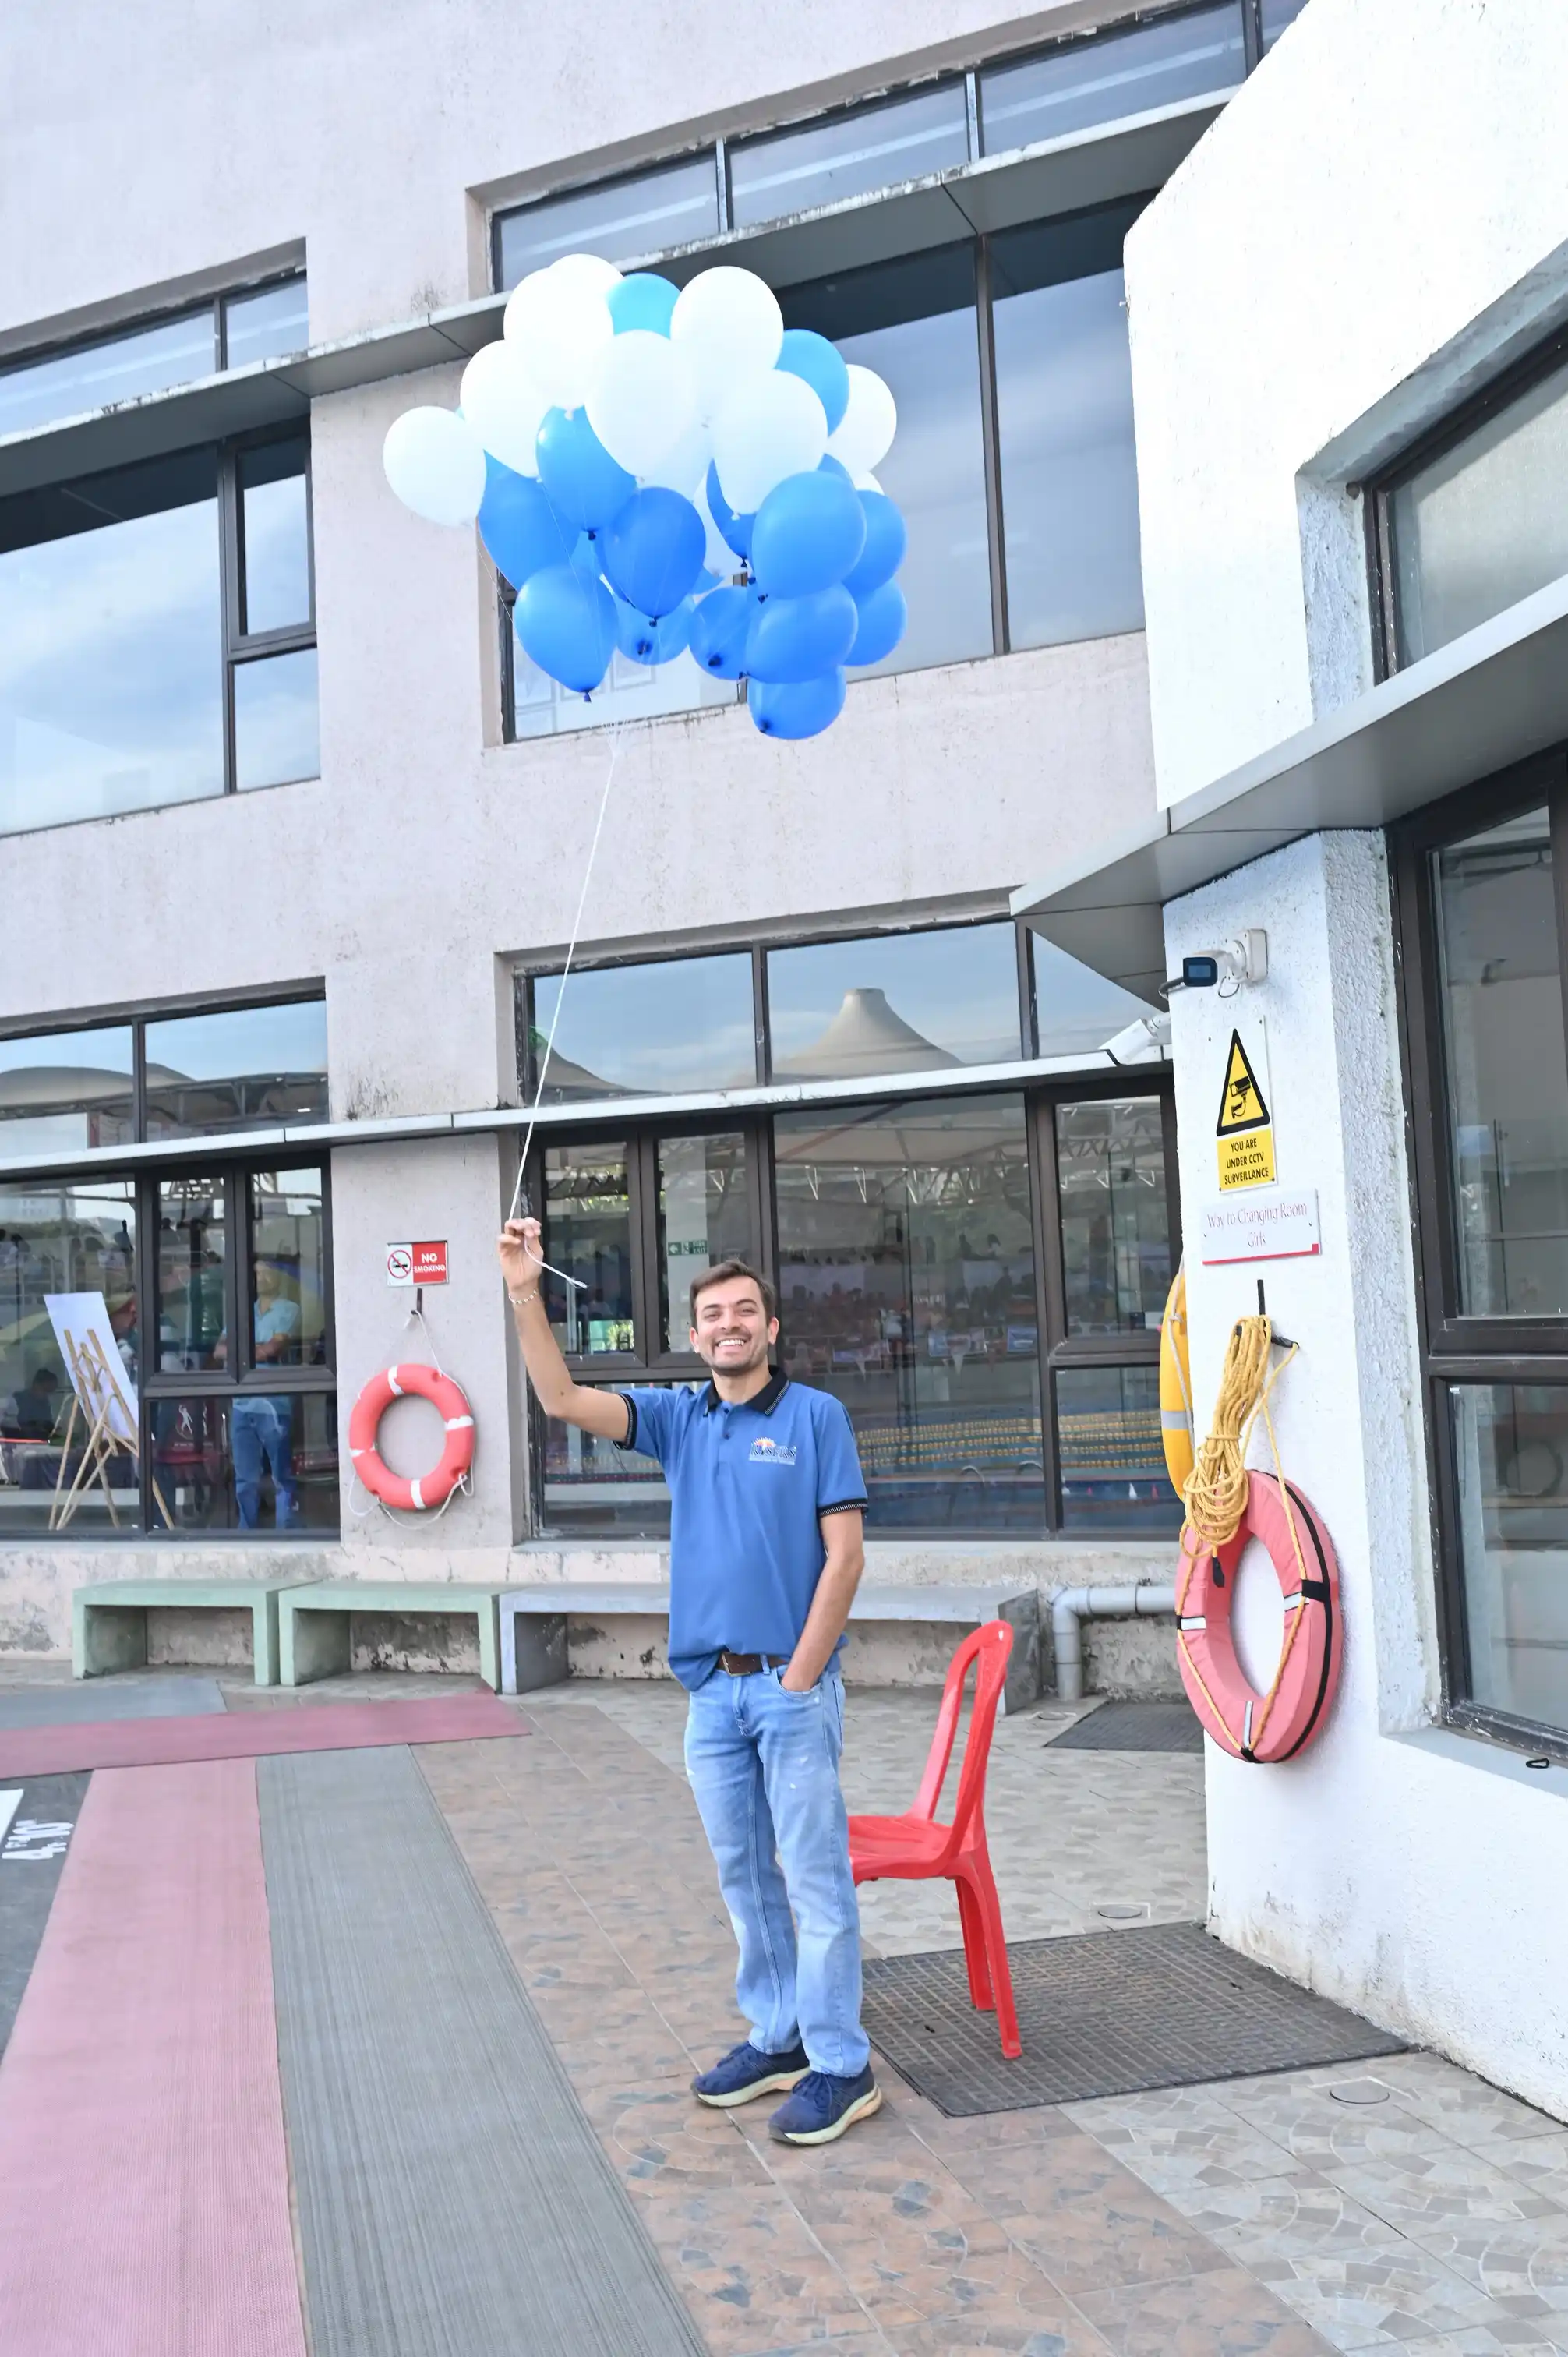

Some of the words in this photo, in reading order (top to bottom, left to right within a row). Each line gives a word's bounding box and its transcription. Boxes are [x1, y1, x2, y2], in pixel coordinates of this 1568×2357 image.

[1231, 1140, 1244, 1153] YOU
[1245, 1138, 1257, 1150] ARE
[1226, 1155, 1248, 1169] UNDER
[1248, 1151, 1264, 1164] CCTV
[1224, 1167, 1269, 1185] SURVEILLANCE
[1227, 1212, 1236, 1225] to
[1238, 1206, 1278, 1226] Changing
[1280, 1203, 1308, 1218] Room
[1247, 1231, 1266, 1248] Girls
[421, 1253, 437, 1263] NO
[413, 1263, 445, 1274] SMOKING
